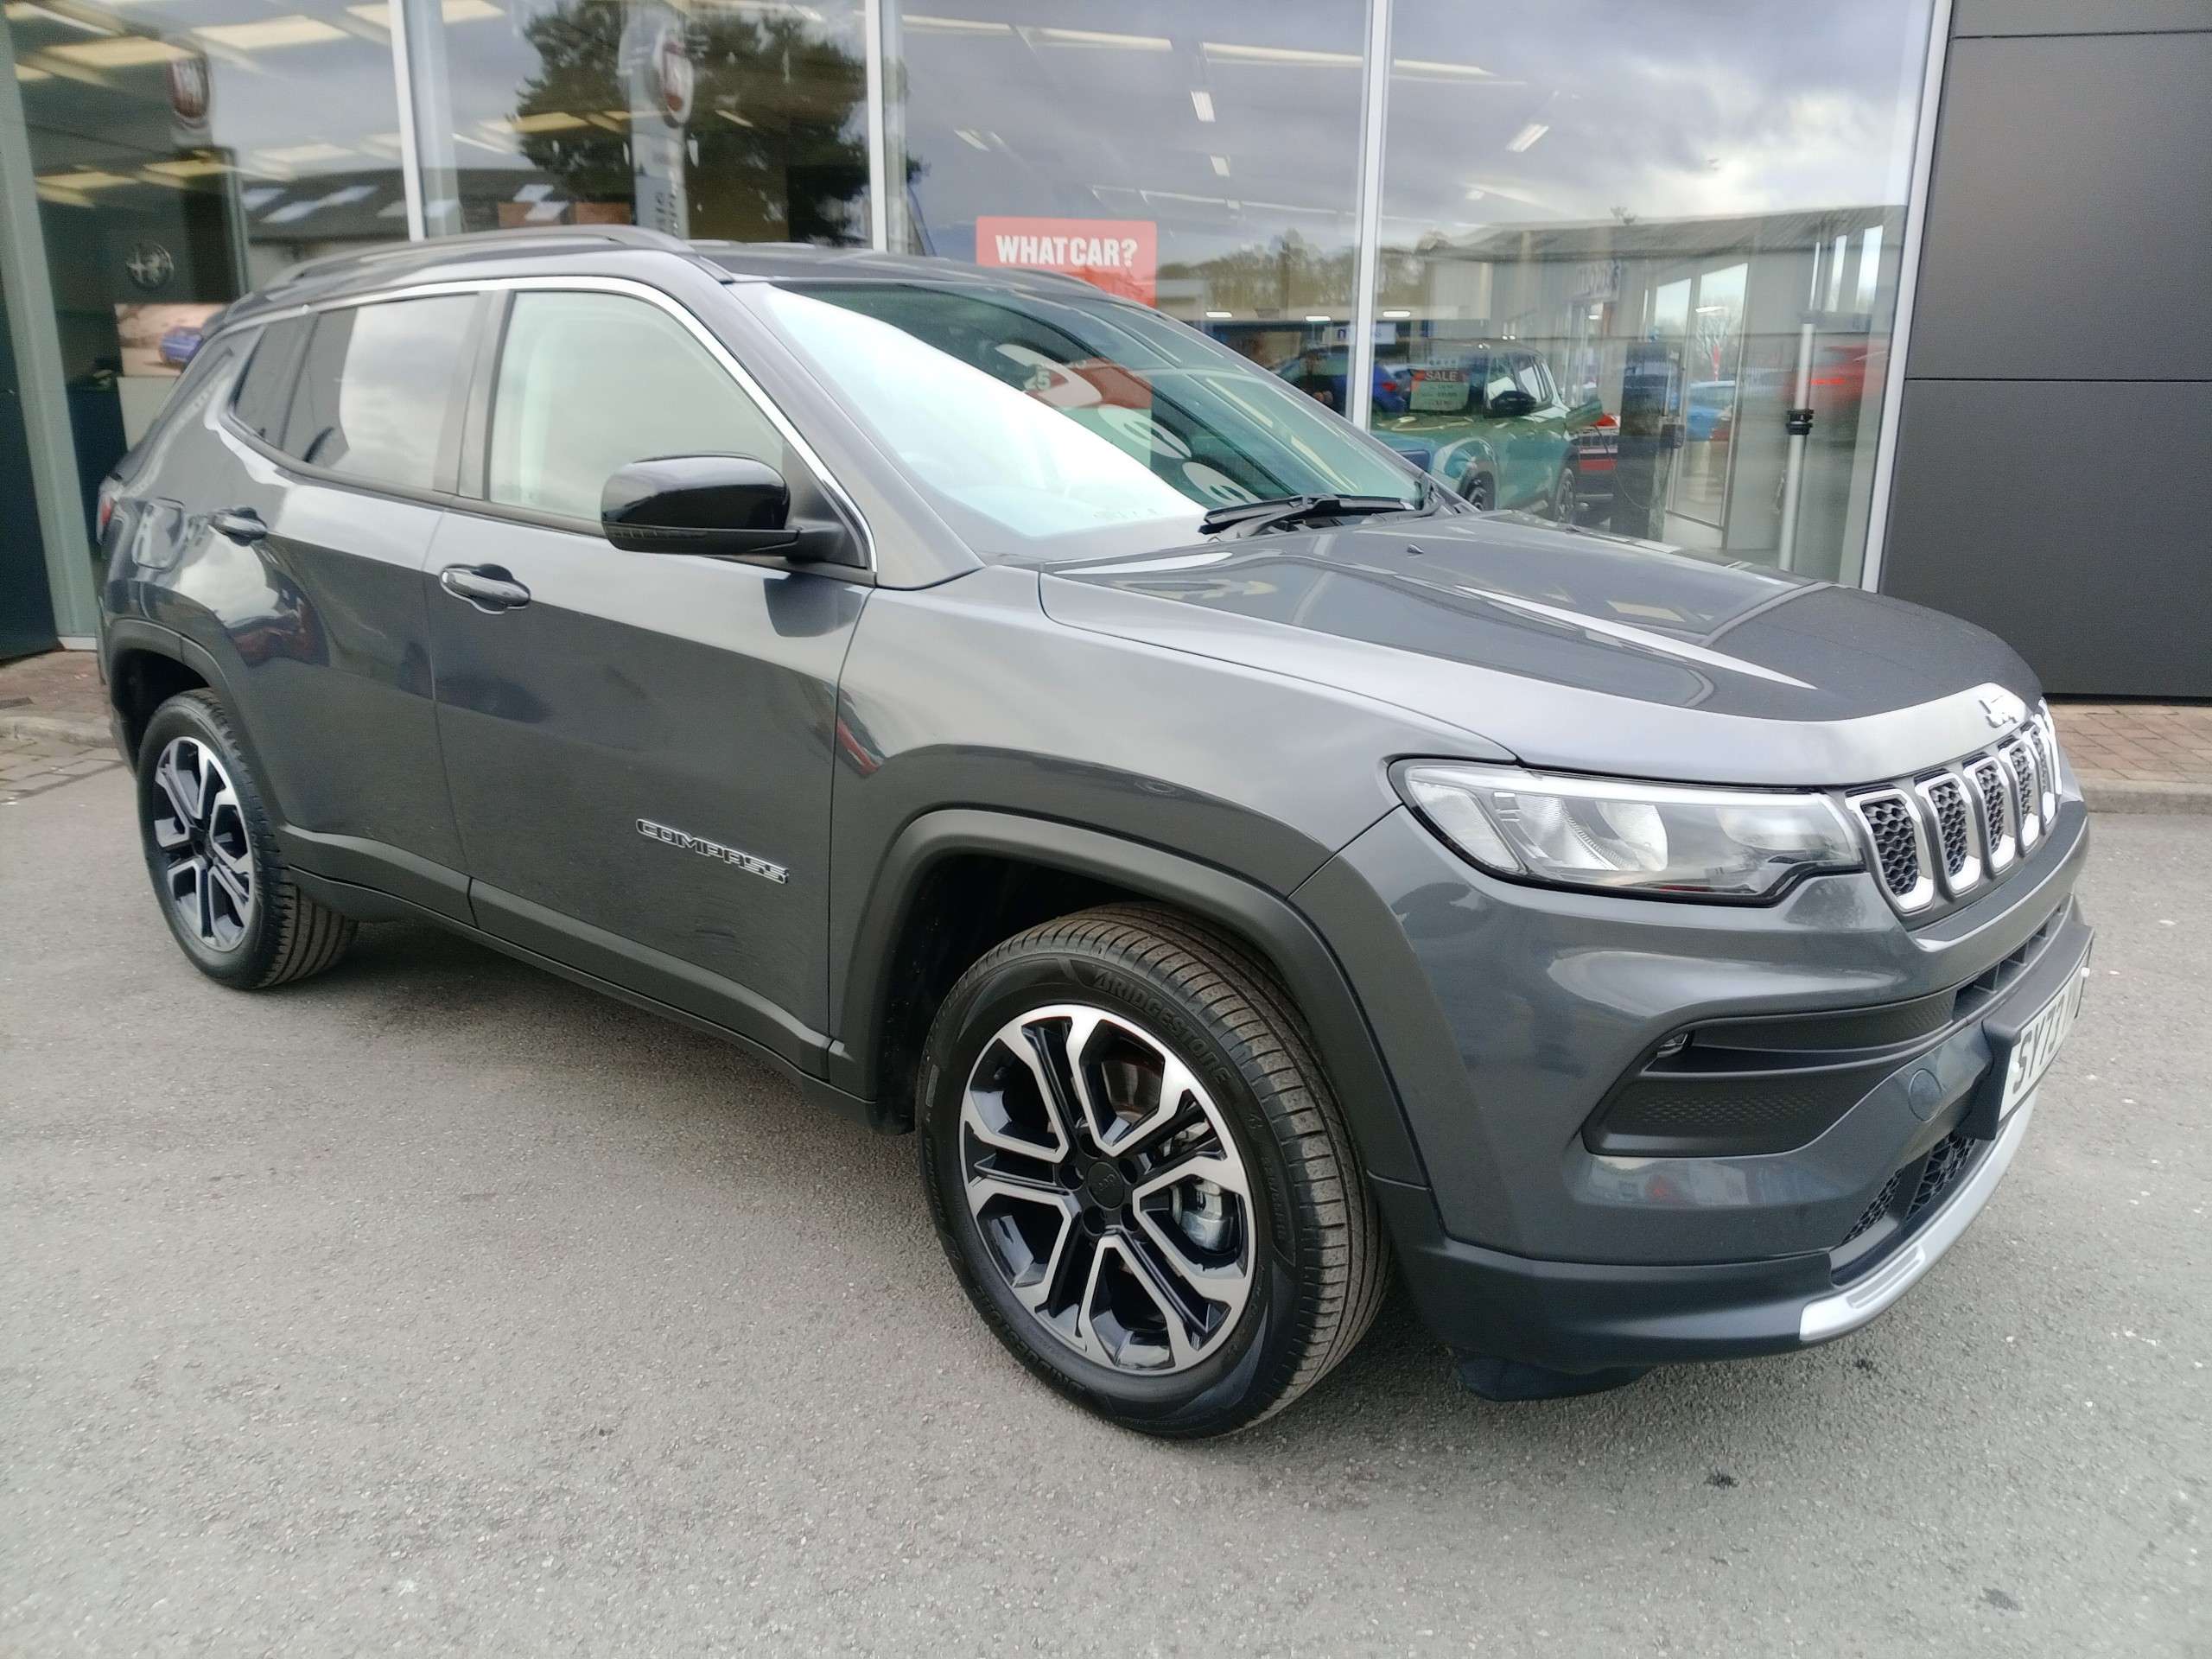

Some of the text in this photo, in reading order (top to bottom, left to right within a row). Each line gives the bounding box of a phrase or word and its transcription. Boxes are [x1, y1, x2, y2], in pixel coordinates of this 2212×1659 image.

[995, 234, 1138, 268] WHAT CAR?
[1426, 371, 1459, 381] SALE
[636, 818, 789, 884] COMPASS
[1092, 970, 1232, 1084] BRIDGESTONE
